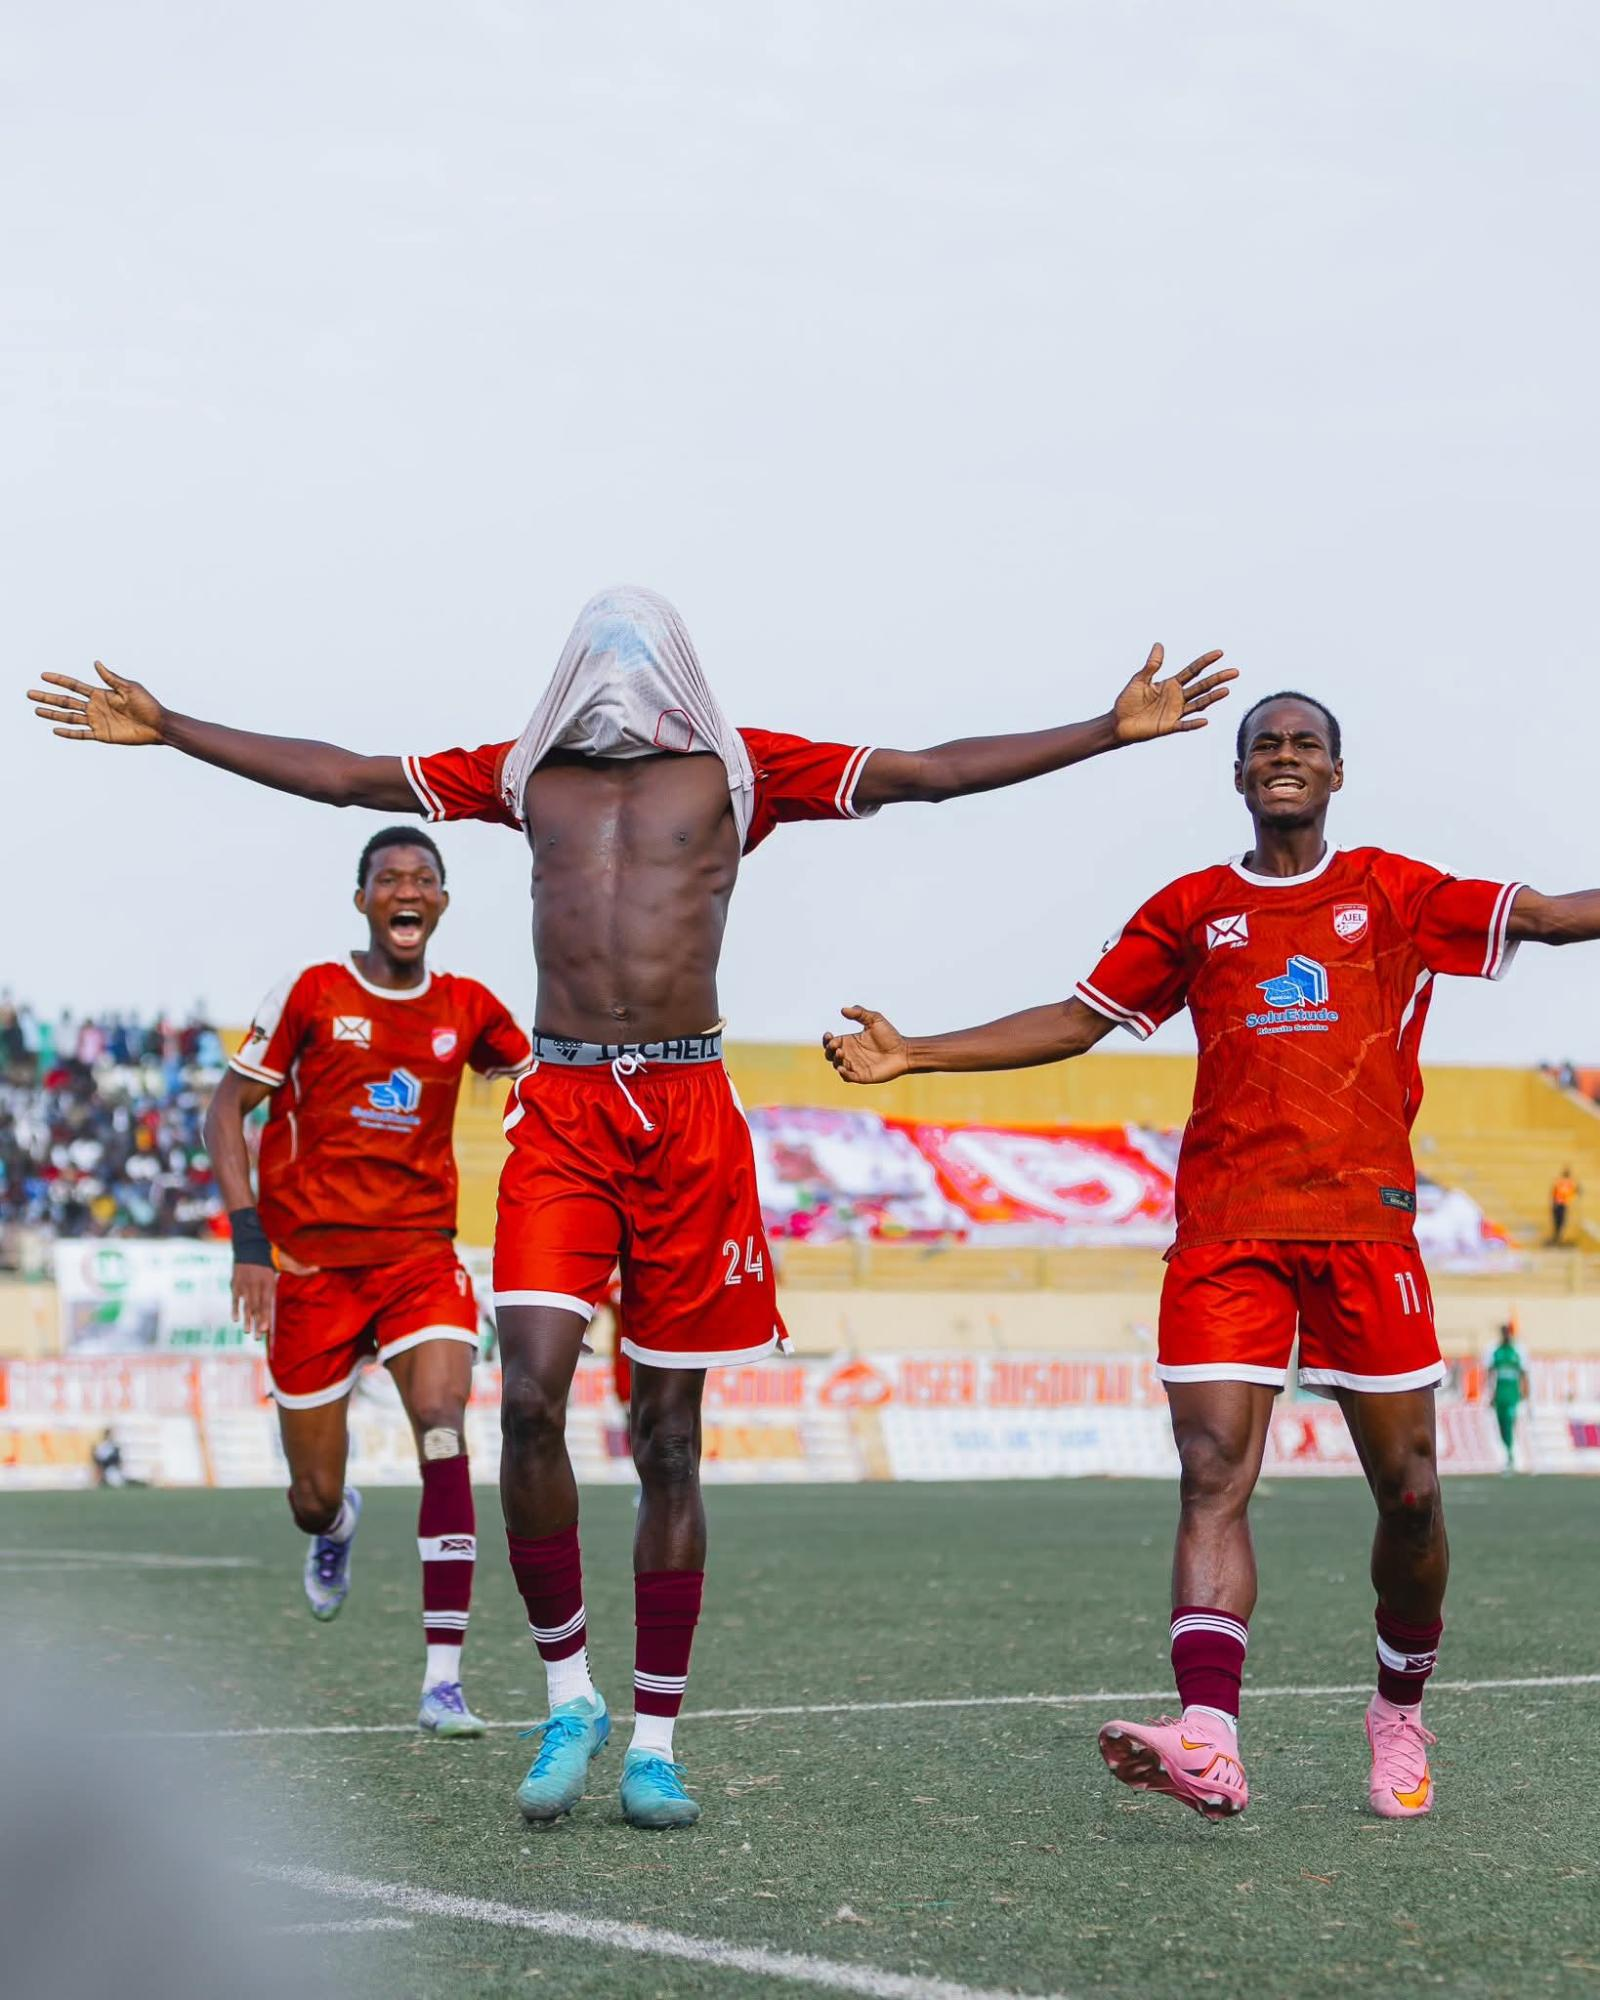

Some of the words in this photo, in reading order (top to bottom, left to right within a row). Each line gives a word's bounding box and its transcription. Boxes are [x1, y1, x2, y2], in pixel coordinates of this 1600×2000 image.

[1342, 913, 1364, 922] AJEL
[1246, 1008, 1339, 1028] SoluEtude
[723, 1235, 763, 1285] 24
[455, 1269, 467, 1296] 9
[1394, 1271, 1420, 1315] 11
